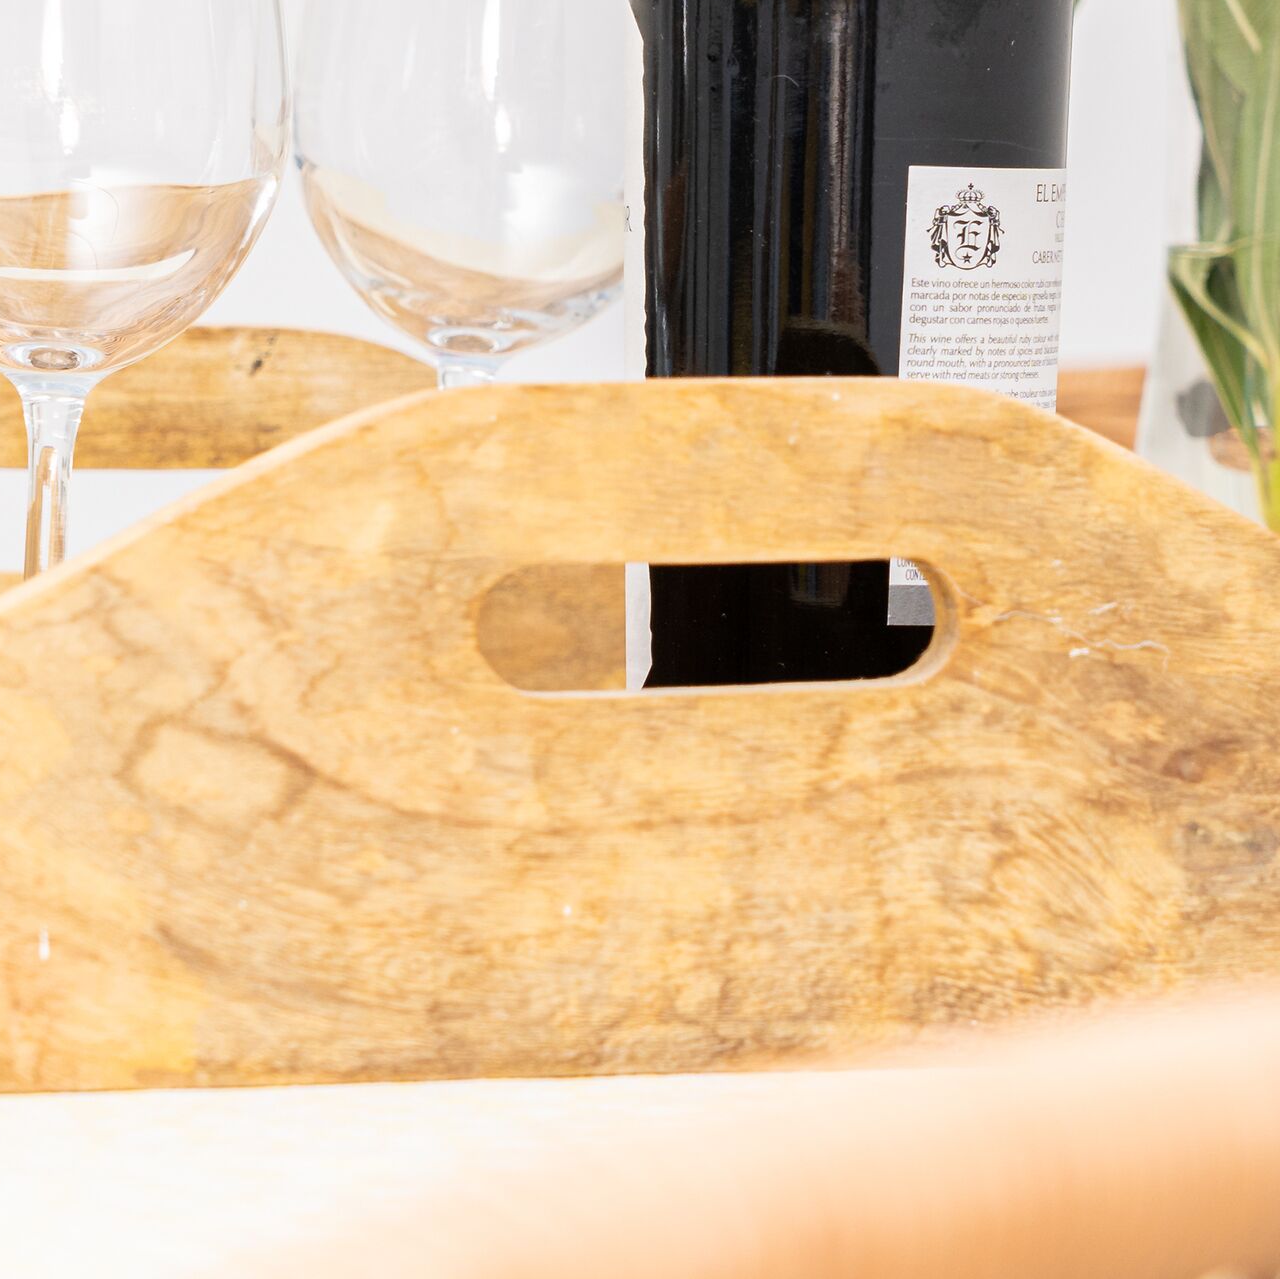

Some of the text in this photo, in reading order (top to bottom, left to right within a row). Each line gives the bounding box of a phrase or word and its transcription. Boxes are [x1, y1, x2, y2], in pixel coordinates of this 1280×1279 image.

[1036, 183, 1049, 202] EL
[911, 277, 929, 288] Este
[931, 278, 951, 288] vino
[952, 278, 978, 289] ofrece
[980, 280, 990, 289] un
[991, 278, 1021, 289] hermoso
[1021, 278, 1035, 289] color
[910, 290, 950, 300] marcada
[952, 292, 967, 303] por
[968, 292, 990, 301] notas
[991, 291, 1001, 301] de
[1001, 292, 1027, 303] especias
[909, 303, 927, 312] con
[933, 304, 945, 312] un
[950, 303, 972, 313] sabor
[976, 303, 1021, 315] pronunciado
[1023, 304, 1031, 313] de
[908, 314, 948, 326] degustar
[949, 317, 965, 325] con
[966, 317, 992, 325] carnes
[992, 317, 1009, 327] rojas
[908, 333, 926, 343] This
[930, 334, 952, 343] wine
[954, 333, 977, 344] offers
[987, 334, 1018, 344] beautiful
[907, 346, 937, 358] clearly
[940, 346, 973, 355] marked
[975, 346, 985, 358] by
[987, 348, 1007, 356] notes
[1008, 346, 1016, 355] of
[907, 358, 935, 368] round
[969, 358, 987, 368] with
[993, 359, 1031, 370] pronounced
[906, 371, 931, 379] serve
[932, 369, 952, 379] with
[953, 370, 967, 380] red
[968, 372, 990, 380] meats
[991, 372, 999, 380] or
[1000, 371, 1020, 382] strong
